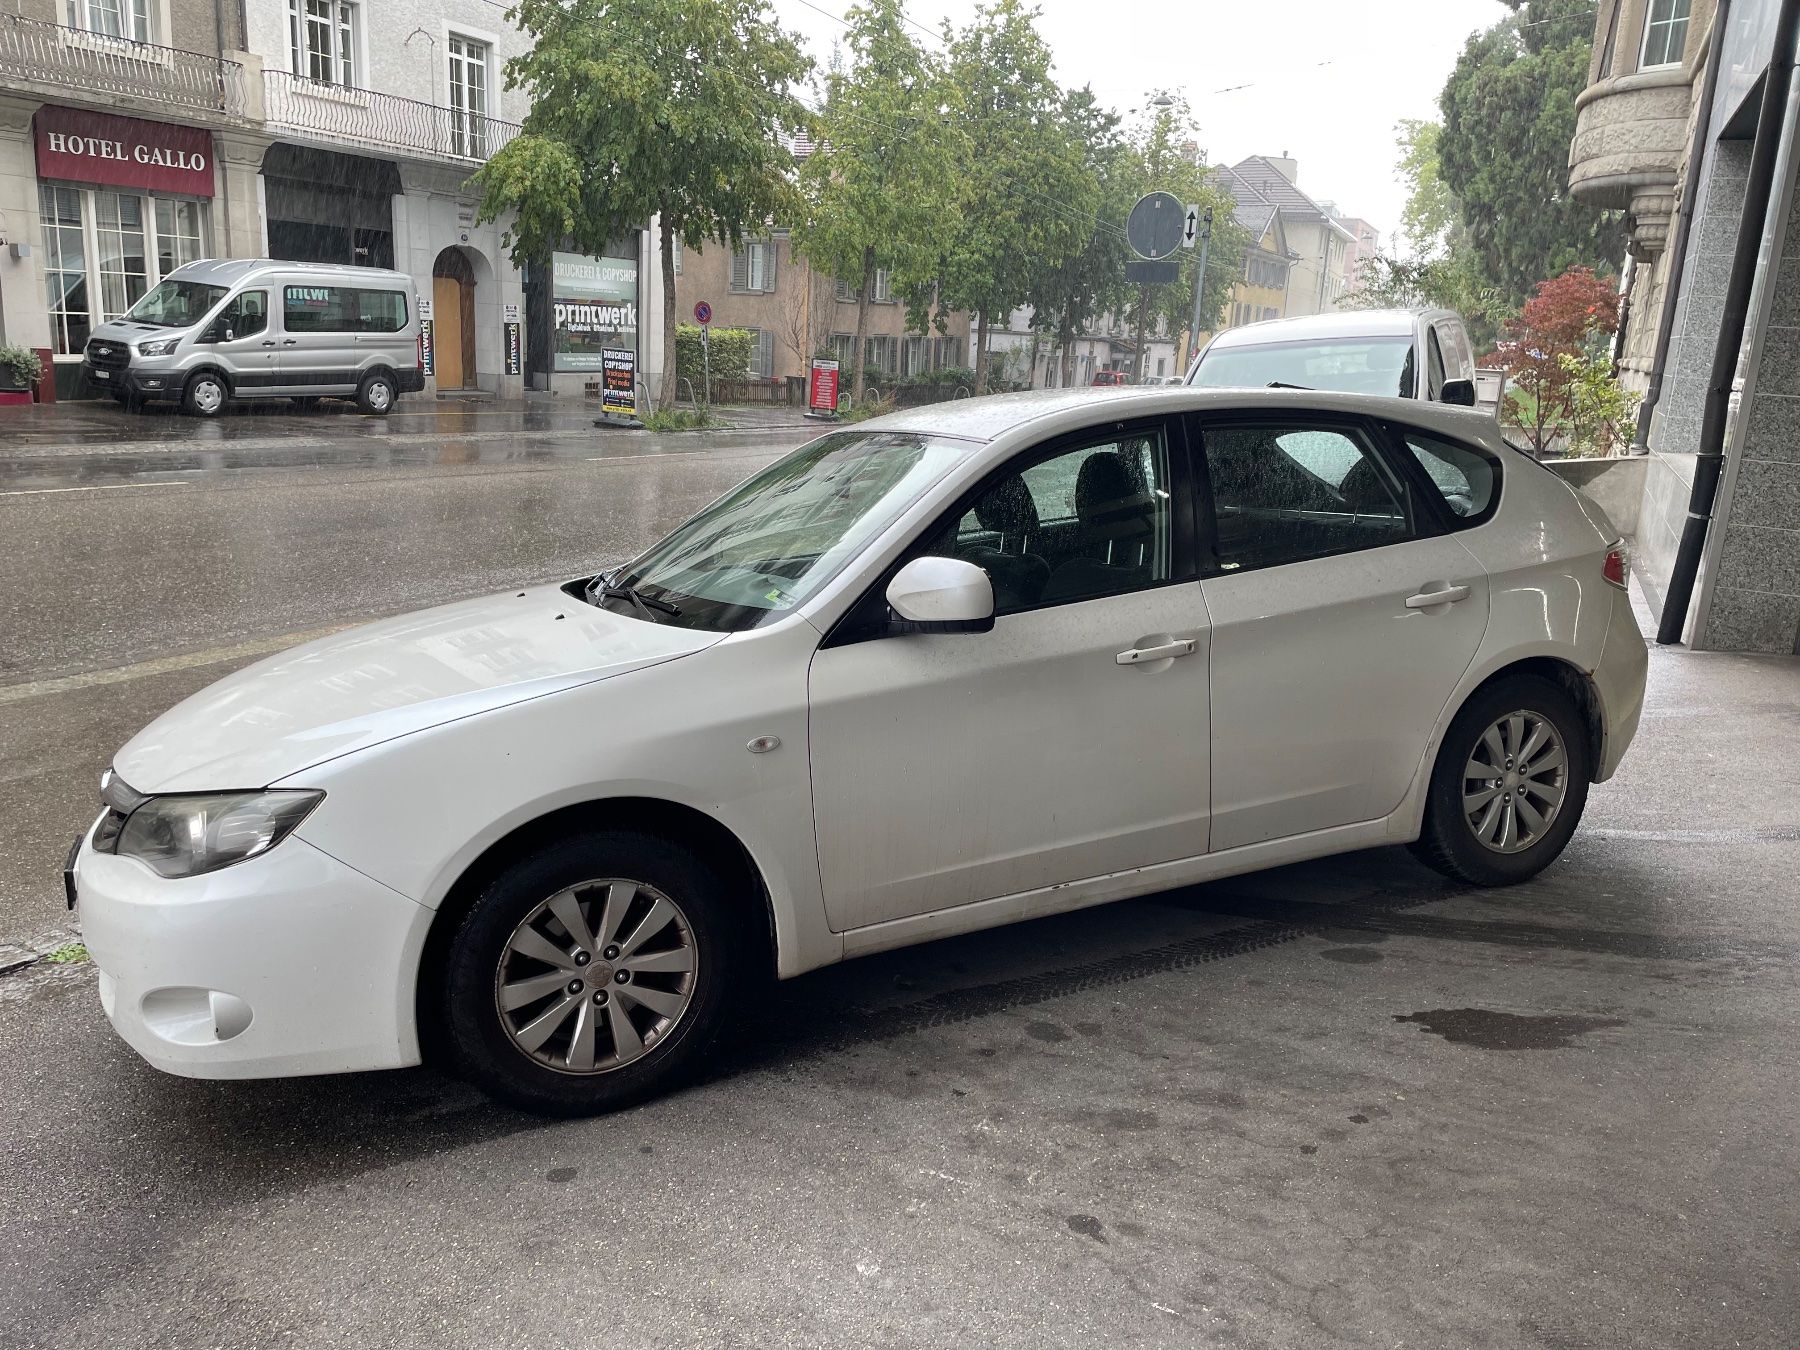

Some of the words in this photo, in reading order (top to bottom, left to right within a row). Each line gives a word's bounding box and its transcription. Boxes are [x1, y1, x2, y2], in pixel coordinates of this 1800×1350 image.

[48, 132, 129, 161] HOTEL
[134, 144, 206, 171] GALLO
[554, 262, 595, 279] DRUCKEREI
[602, 268, 637, 282] COPYSHOP
[554, 302, 637, 330] printwerk
[420, 320, 432, 376] printwerk
[508, 323, 519, 375] printwerk
[603, 350, 634, 361] DRUCKEREI
[604, 360, 634, 371] COPYSHOP
[603, 386, 635, 398] printwerk
